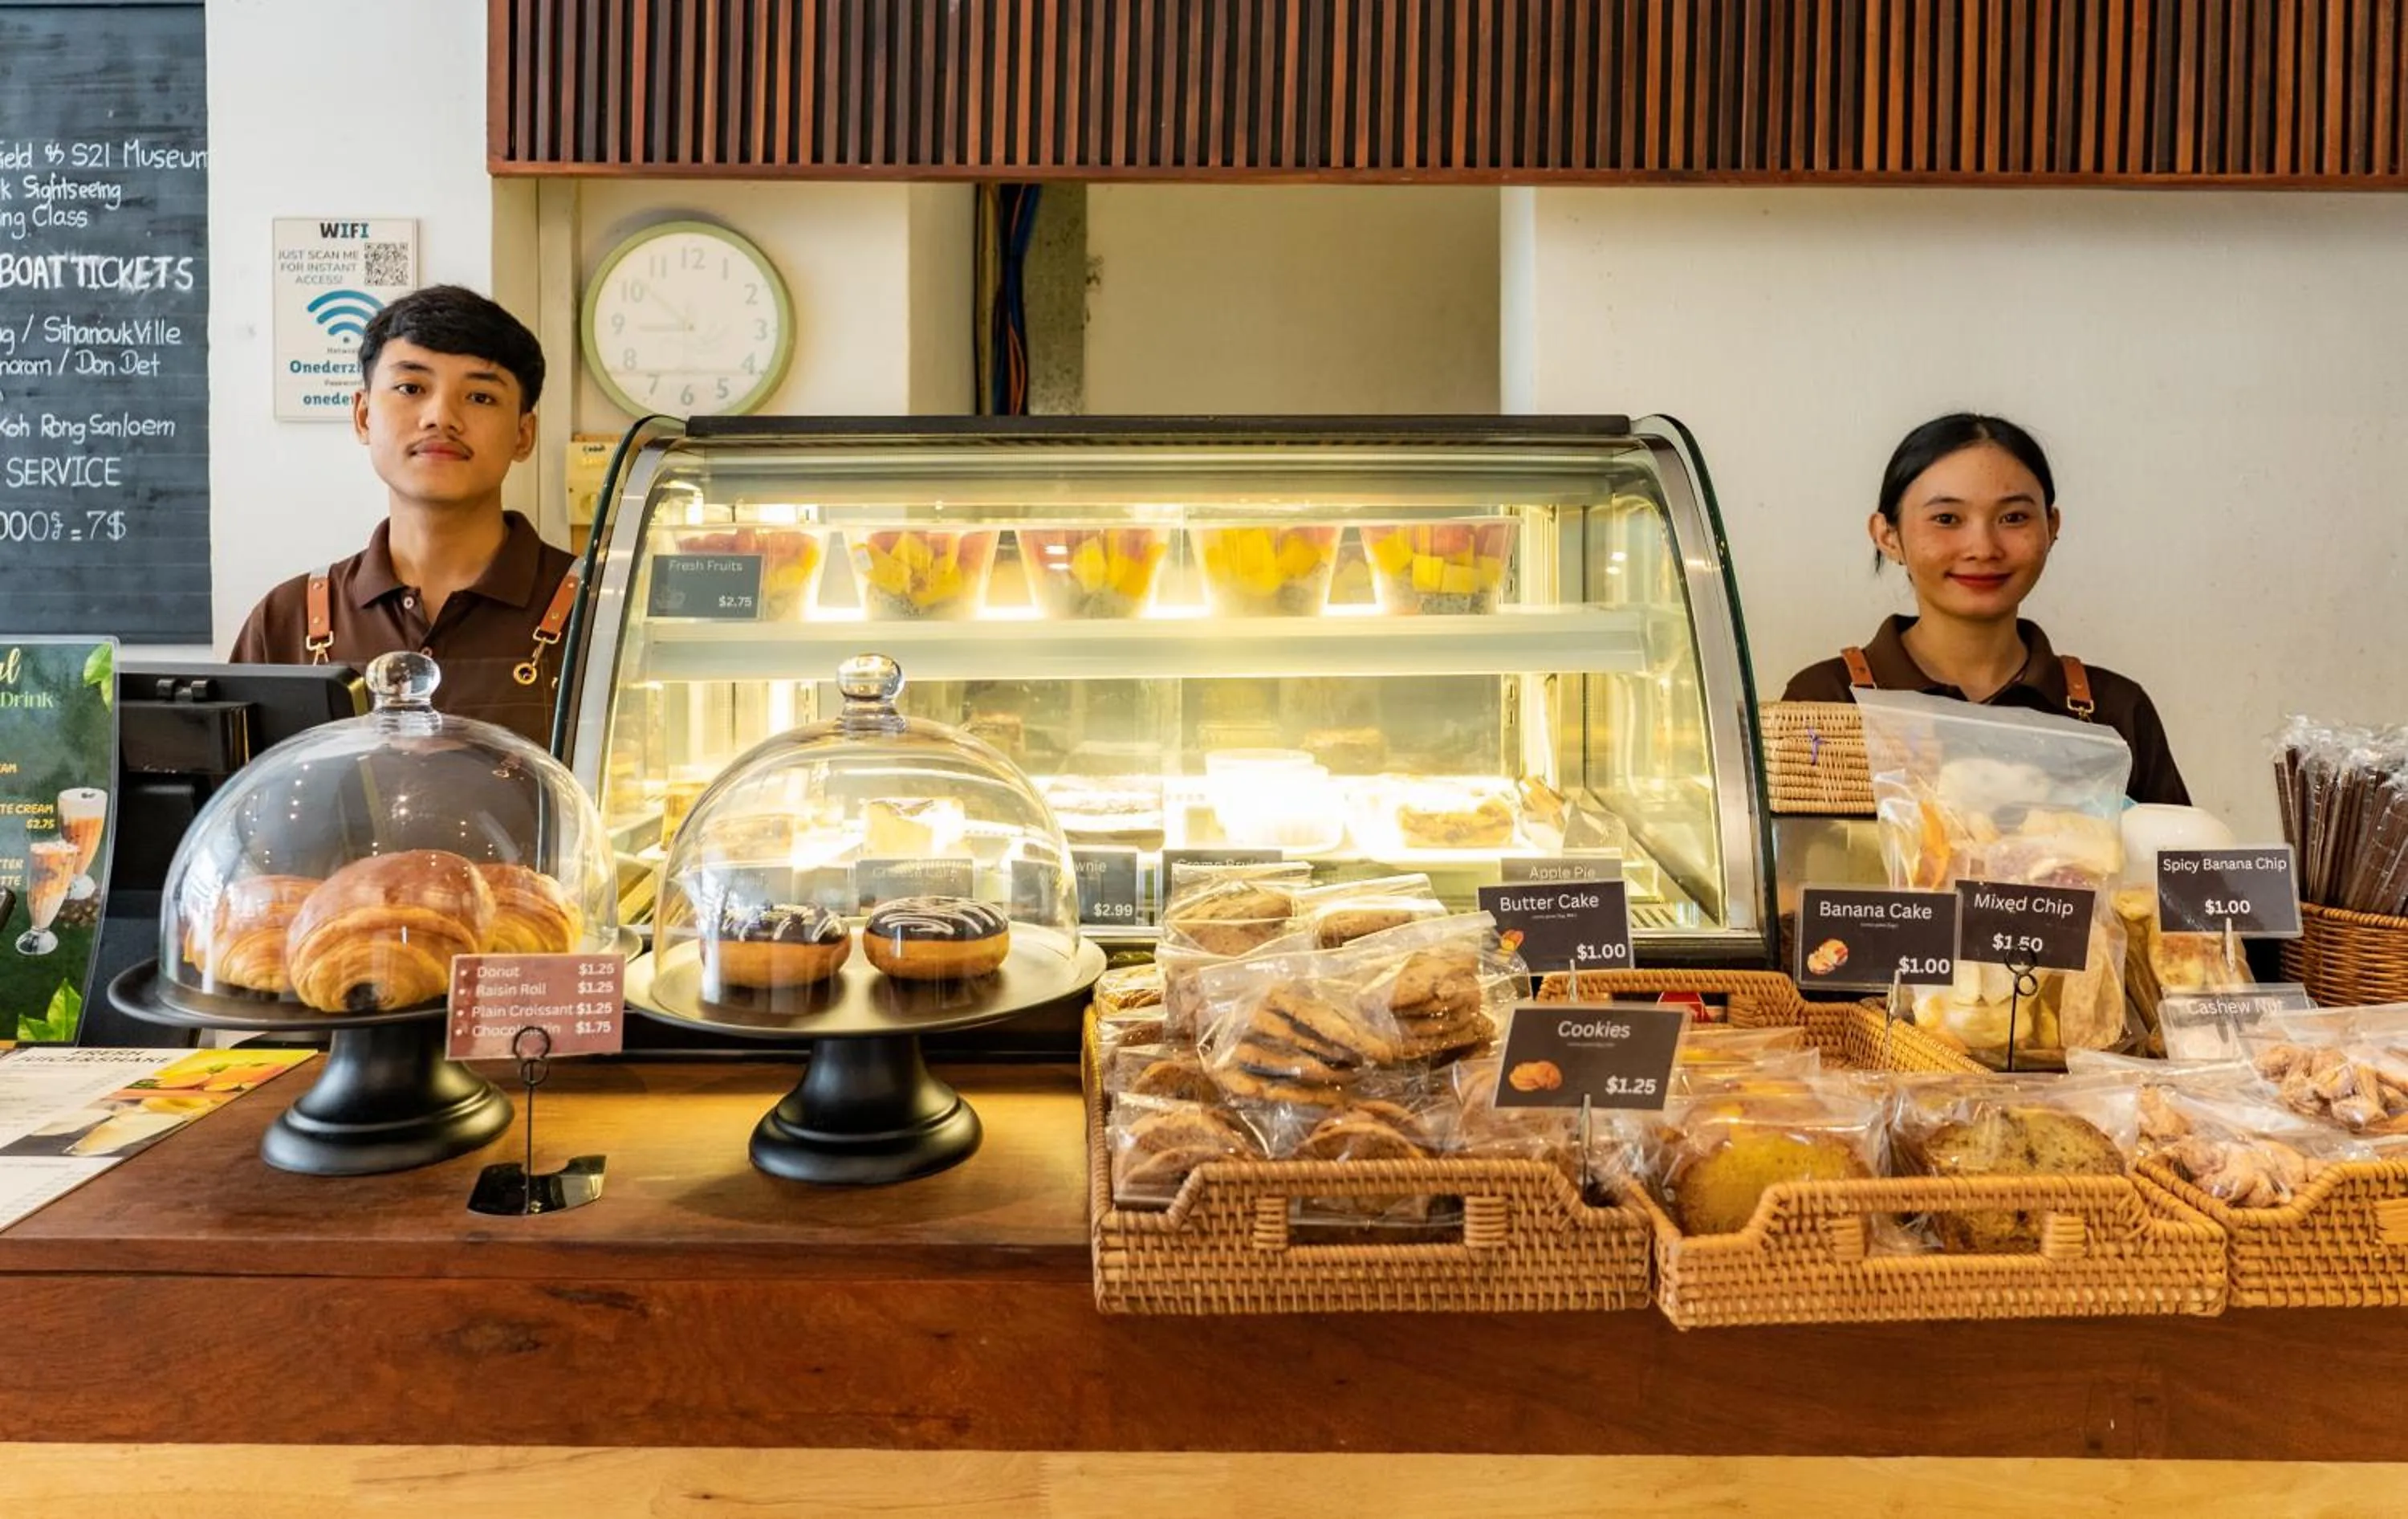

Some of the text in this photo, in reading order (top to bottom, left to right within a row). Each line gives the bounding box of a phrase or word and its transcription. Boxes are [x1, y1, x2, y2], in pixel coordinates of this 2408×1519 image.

[72, 143, 110, 168] S21
[23, 172, 121, 210] Sightseeing
[32, 204, 88, 227] Class
[320, 222, 369, 238] WIFI
[278, 250, 359, 260] JUST SCAN ME
[681, 247, 706, 270] 12
[0, 253, 194, 291] BOAT TICKETS
[280, 263, 357, 272] FOR INSTANT
[649, 255, 667, 279] 11
[722, 258, 729, 280] 1
[620, 280, 644, 303] 10
[744, 283, 759, 305] 2
[611, 313, 625, 336] 9
[754, 318, 768, 341] 3
[75, 349, 116, 376] Don
[120, 349, 161, 377] Det
[622, 348, 637, 371] 8
[741, 352, 756, 375] 4
[647, 373, 661, 395] 7
[716, 377, 730, 399] 5
[681, 384, 694, 406] 6
[41, 413, 86, 444] Rong
[89, 412, 176, 438] Sanloem
[6, 455, 122, 488] SERVICE
[87, 510, 127, 541] 7$
[669, 560, 743, 572] Fresh Fruits
[718, 595, 752, 608] $2.75
[1, 691, 54, 707] Drink
[15, 804, 54, 815] CREAM
[1529, 865, 1596, 881] Apple Pie
[2163, 857, 2287, 874] Spicy Banana Chip
[1094, 902, 1133, 916] $2.99
[1499, 893, 1600, 912] Butter Cake
[1820, 902, 1932, 920] Banana Cake
[1974, 893, 2073, 918] Mixed Chip
[2205, 899, 2251, 915] $1.00
[1576, 943, 1626, 960] $1.00
[477, 963, 615, 978] Donut $1.25
[1898, 957, 1950, 975] $1.00
[476, 981, 614, 997] Raisin Roll $1.25
[471, 1003, 612, 1018] Plain Croissant $1.25
[2188, 1000, 2250, 1015] Cashew
[576, 1021, 611, 1035] $1.75
[1558, 1020, 1631, 1039] Cookies
[1605, 1075, 1658, 1094] $1.25
